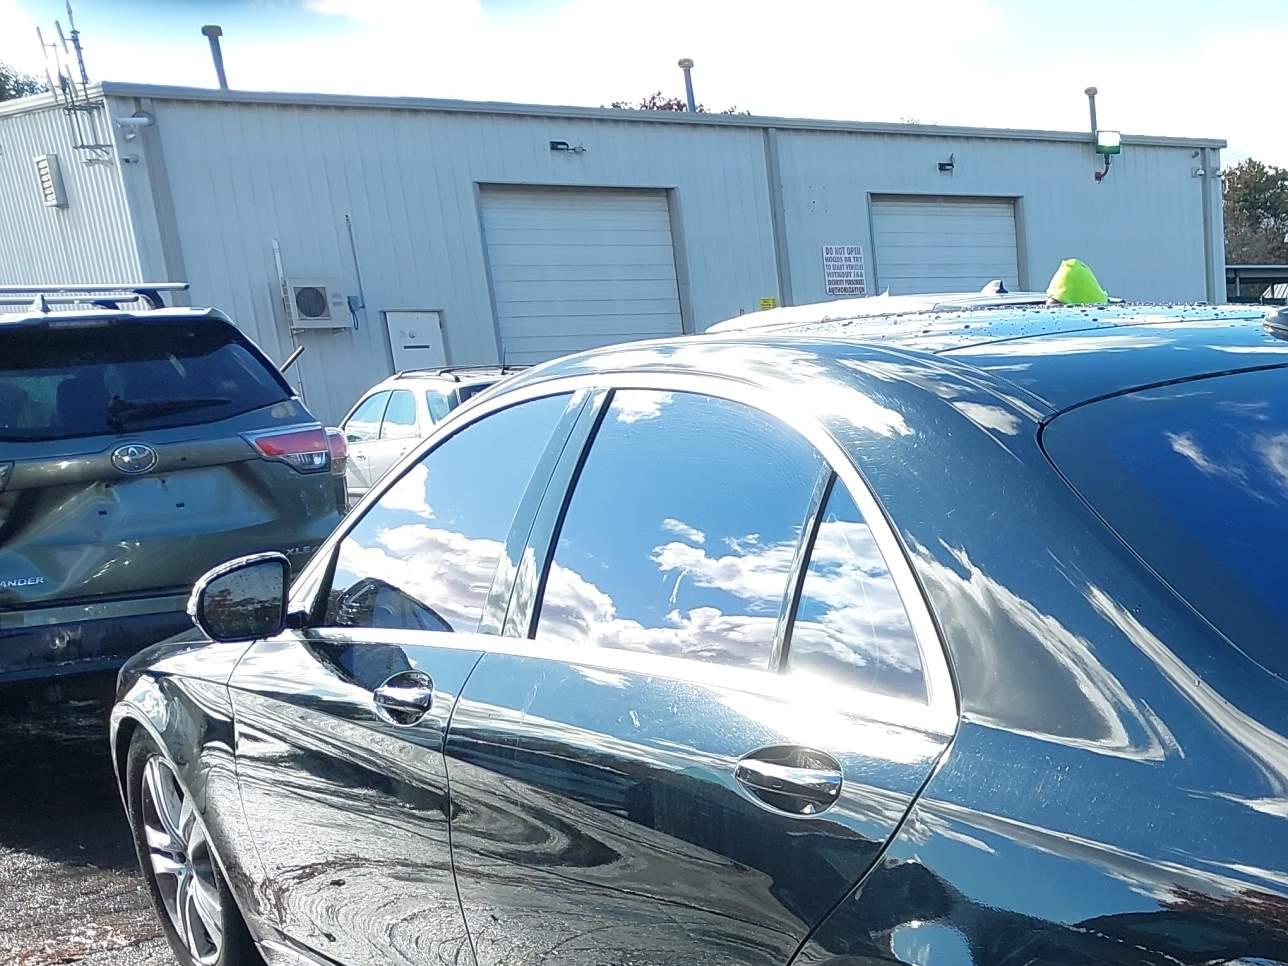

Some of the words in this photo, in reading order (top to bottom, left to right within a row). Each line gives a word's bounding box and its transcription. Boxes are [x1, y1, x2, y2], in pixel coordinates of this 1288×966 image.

[825, 246, 834, 256] DO
[834, 246, 846, 256] NOT
[846, 246, 861, 256] OPEN
[286, 545, 311, 556] XLE
